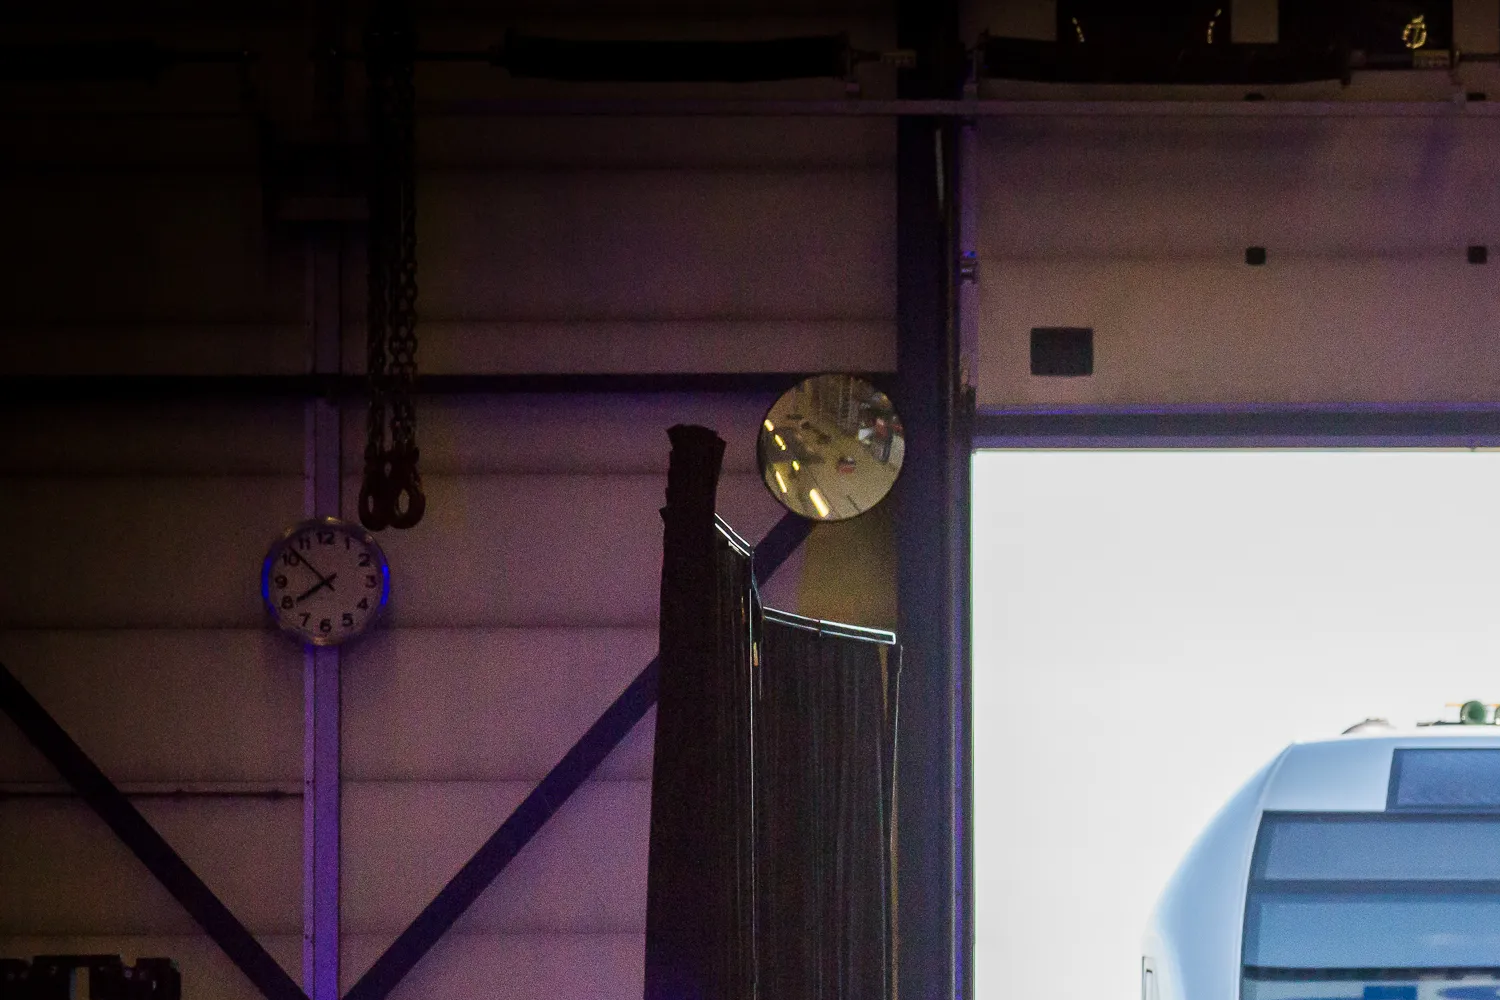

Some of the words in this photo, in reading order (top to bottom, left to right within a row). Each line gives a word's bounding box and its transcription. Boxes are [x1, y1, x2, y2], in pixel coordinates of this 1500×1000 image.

[299, 538, 311, 549] 11
[316, 532, 335, 545] 12
[344, 538, 350, 549] 1
[282, 554, 299, 567] 10
[358, 554, 371, 566] 2
[275, 575, 288, 589] 9
[365, 575, 377, 588] 3
[281, 596, 294, 610] 8
[357, 598, 369, 610] 4
[299, 612, 311, 627] 7
[319, 618, 332, 633] 6
[341, 613, 354, 627] 5
